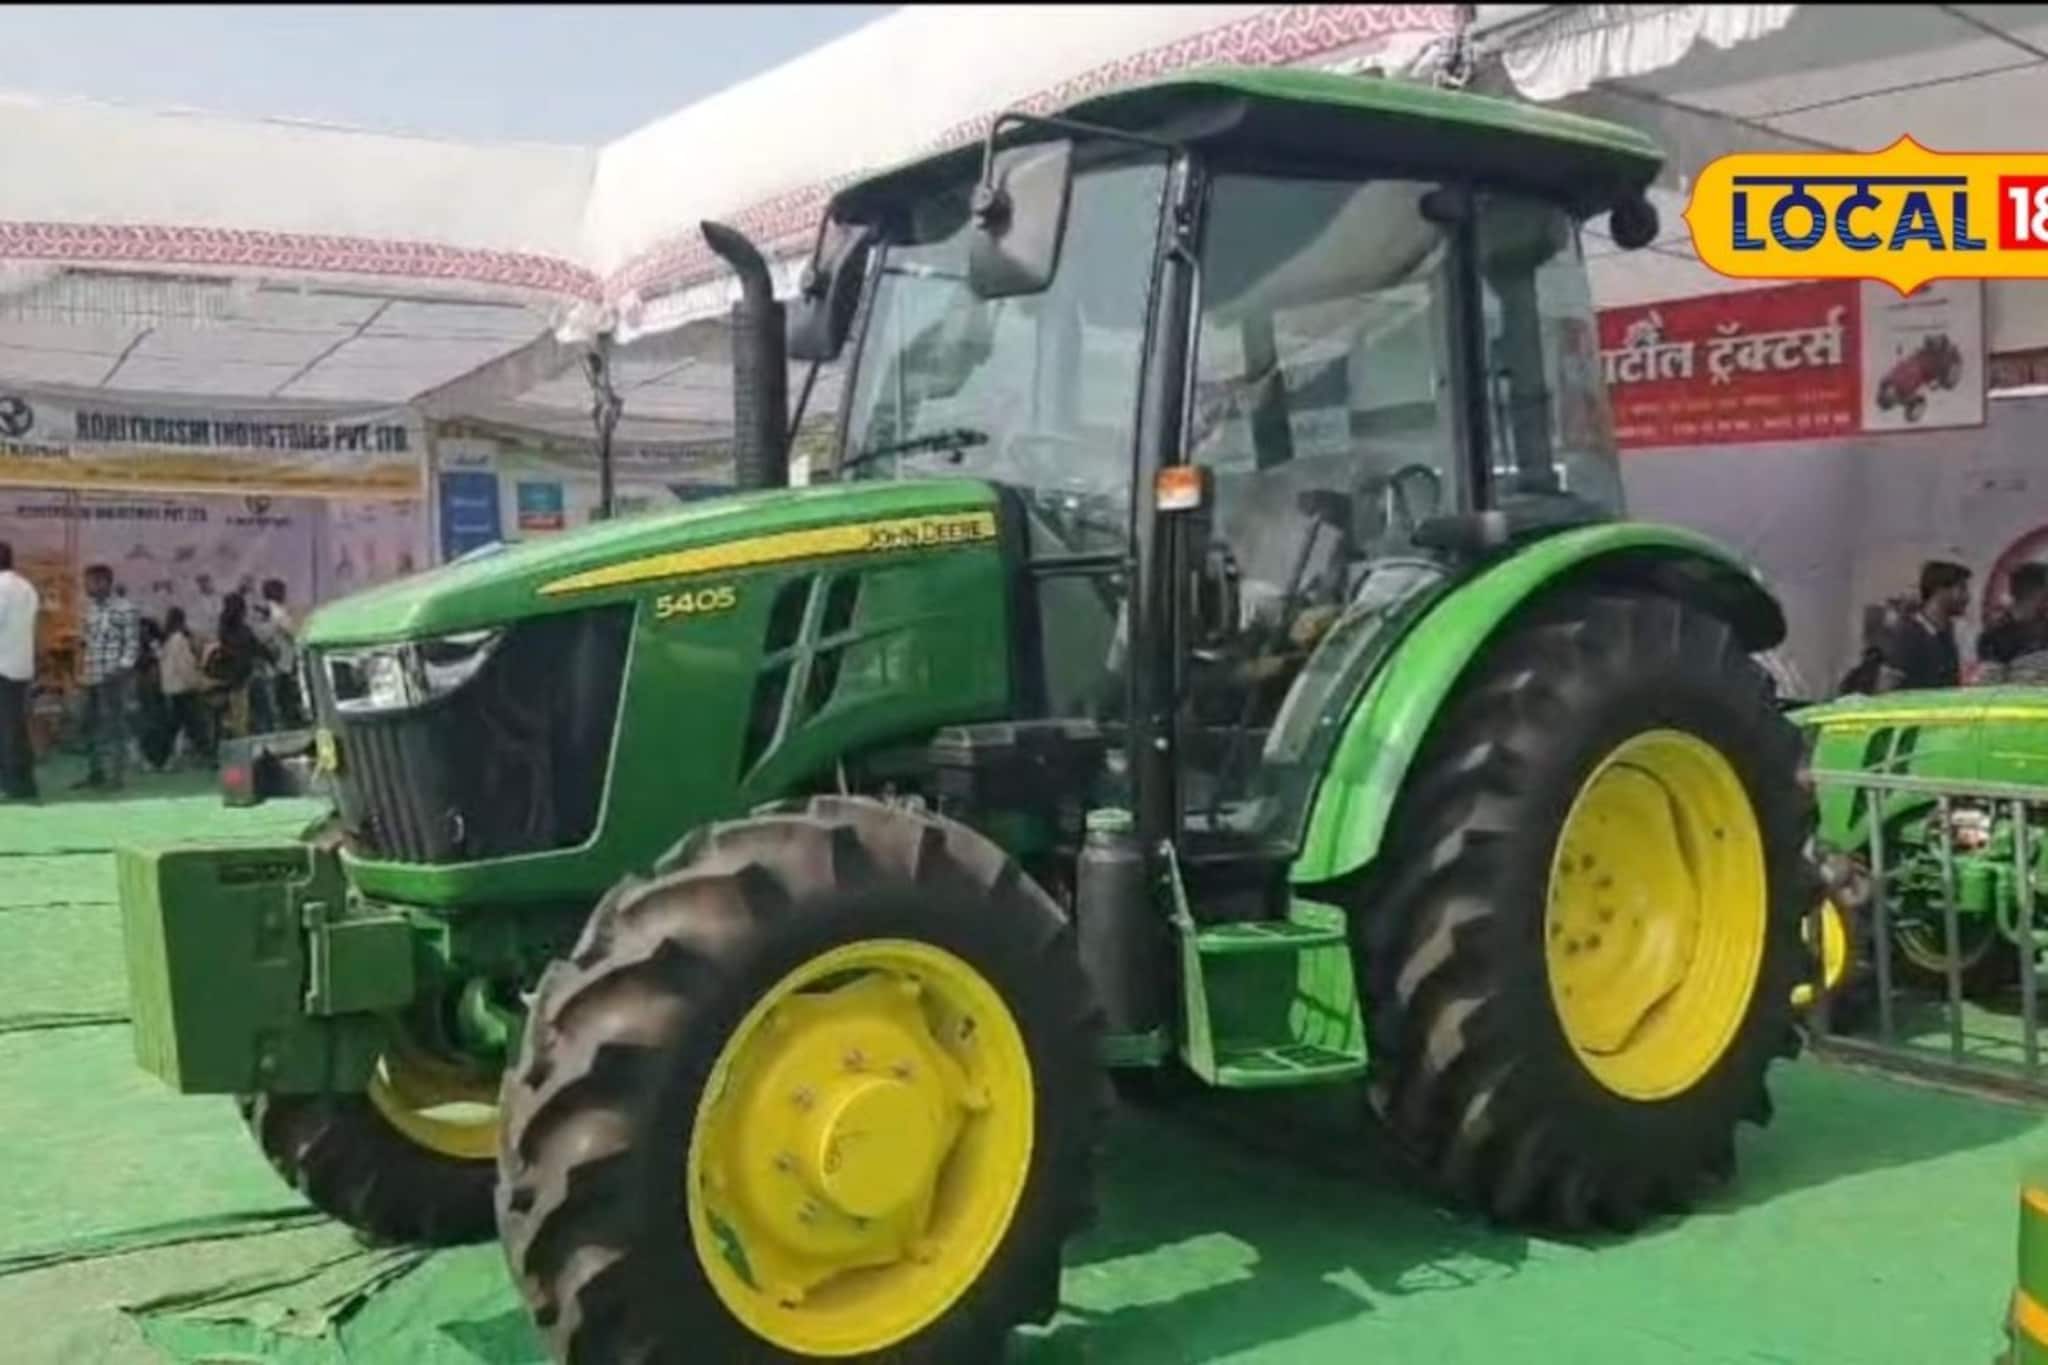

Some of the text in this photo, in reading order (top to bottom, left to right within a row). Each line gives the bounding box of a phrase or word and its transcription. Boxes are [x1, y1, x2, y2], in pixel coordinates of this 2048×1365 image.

[868, 519, 979, 547] JOHN DEERE
[656, 585, 737, 619] 5405
